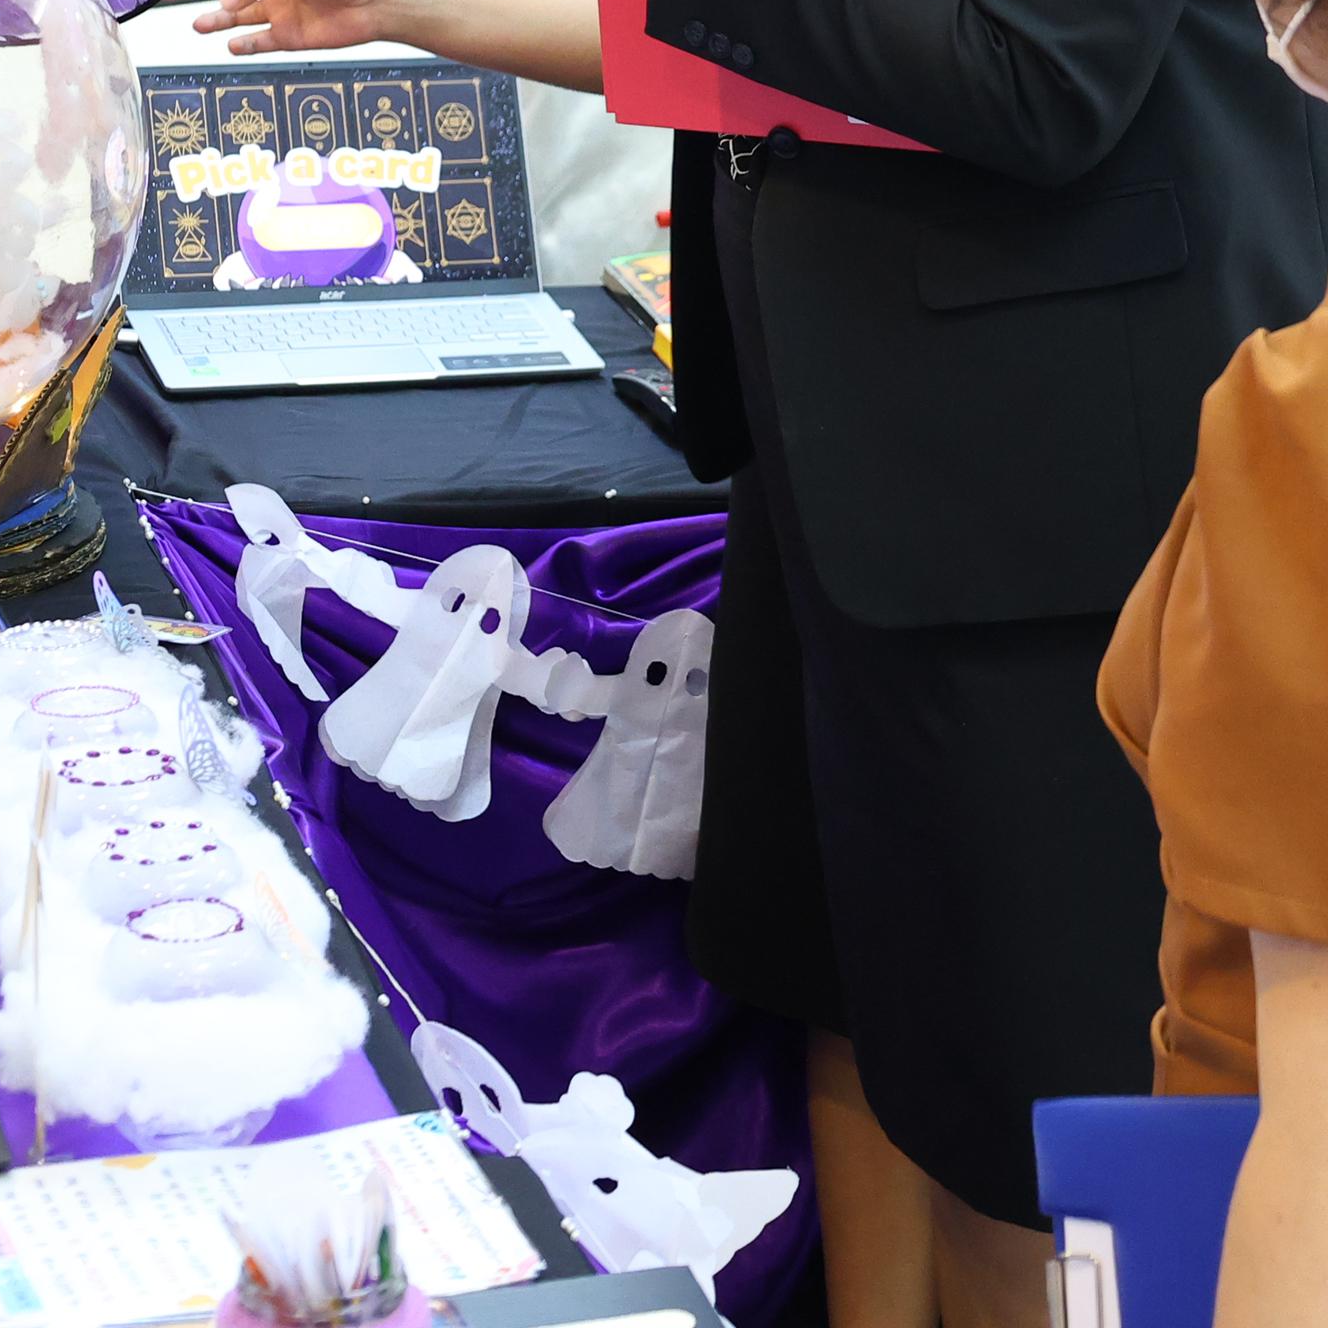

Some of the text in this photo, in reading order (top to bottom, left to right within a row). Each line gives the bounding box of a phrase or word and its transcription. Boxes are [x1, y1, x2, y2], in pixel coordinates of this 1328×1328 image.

[174, 149, 437, 198] Pick a card
